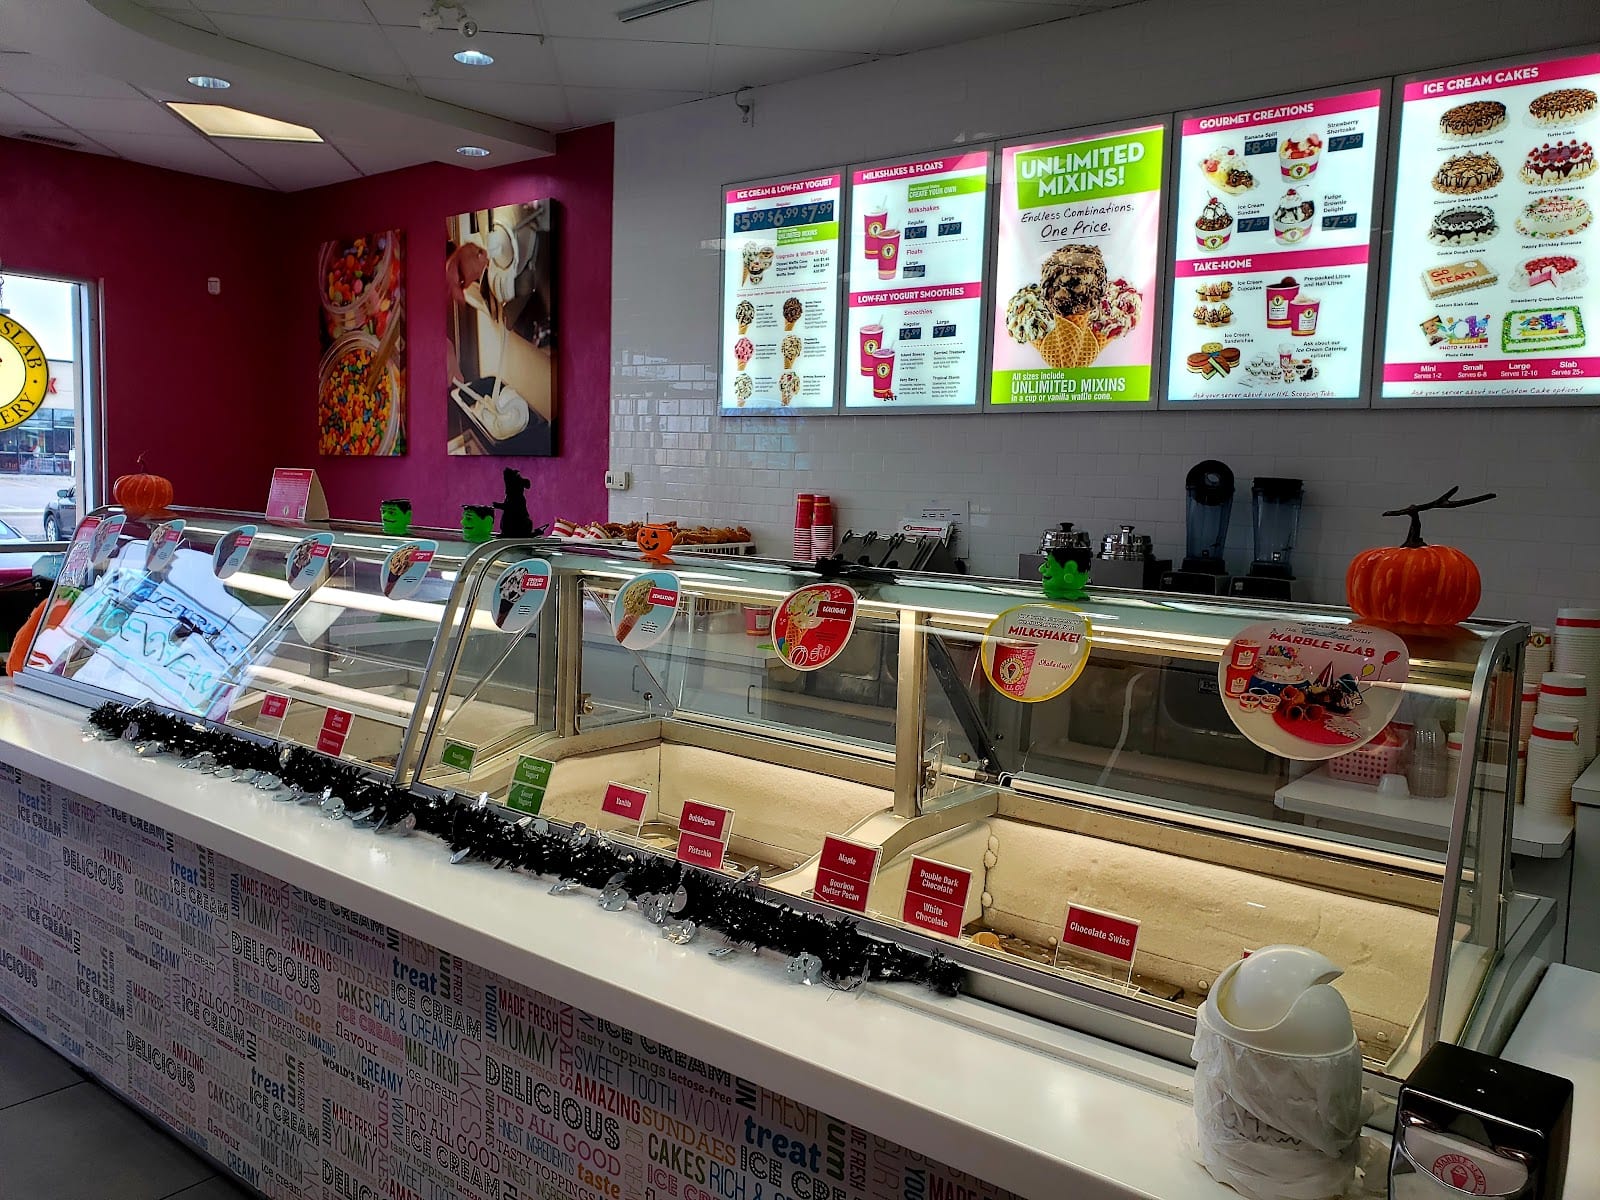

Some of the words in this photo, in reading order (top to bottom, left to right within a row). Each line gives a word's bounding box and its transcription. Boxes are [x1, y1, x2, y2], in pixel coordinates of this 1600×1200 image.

[1423, 82, 1444, 94] ICE
[1446, 74, 1492, 90] CREAM
[1495, 68, 1539, 83] CAKES
[1200, 112, 1251, 129] GOURMET
[1252, 103, 1314, 121] CREATIONS
[863, 166, 909, 180] MILKSHAKES
[916, 161, 944, 172] FLOATS
[1021, 142, 1145, 179] UNLIMITED
[737, 190, 748, 200] ICE
[748, 188, 771, 198] CREAM
[805, 178, 833, 190] YOGURT
[1038, 165, 1125, 198] MIXINS!
[735, 212, 764, 230] $5.99
[768, 207, 798, 226] $6.99
[802, 202, 832, 223] $7.99
[1020, 212, 1060, 223] Endless
[1064, 202, 1134, 218] Combinations.
[1041, 224, 1068, 238] One
[1072, 220, 1111, 235] Price.
[1193, 259, 1252, 272] TAKE-HOME
[858, 294, 888, 304] LOW-FAT
[889, 290, 919, 301] YOGURT
[920, 287, 964, 298] SMOOTHIES
[1012, 372, 1020, 380] All
[1023, 372, 1039, 380] sizes
[1040, 371, 1065, 380] include
[1509, 362, 1530, 371] Large
[1012, 380, 1076, 394] UNLIMITED
[1080, 377, 1126, 392] MIXINS
[1048, 392, 1070, 401] vanilla
[1008, 626, 1081, 643] MILKSHAKE!
[1268, 633, 1332, 651] MARBLE
[1333, 641, 1376, 658] SLAB
[838, 853, 857, 866] Maple
[822, 884, 841, 897] Butter
[830, 878, 855, 891] Bourbon
[920, 868, 943, 883] Double
[943, 874, 959, 888] Dark
[922, 879, 954, 895] Chocolate
[915, 911, 948, 928] Chocolate
[923, 902, 943, 916] White
[1070, 922, 1107, 940] Chocolate
[1107, 932, 1131, 947] Swiss
[232, 930, 320, 994] DELICIOUS
[290, 936, 332, 972] AMAZING
[392, 956, 438, 996] treat
[337, 977, 372, 1014] CAKES
[374, 994, 396, 1026] RICH
[411, 1013, 458, 1056] CREAMY
[391, 980, 416, 1010] ICE
[421, 994, 482, 1042] CREAM
[485, 984, 498, 1042] YOGURT
[499, 987, 525, 1020] MADE
[528, 1000, 558, 1035] FRESH
[246, 1030, 257, 1062] FUN
[498, 1009, 558, 1070] YUMMY
[576, 1028, 604, 1049] tasty
[608, 1042, 666, 1077] toppings
[252, 1066, 286, 1103] treat
[361, 1055, 404, 1096] CREAMY
[574, 1045, 623, 1088] SWEET
[629, 1070, 678, 1115] TOOTH
[669, 1069, 732, 1106] lactose-free
[486, 1055, 620, 1150] DELICIOUS
[575, 1072, 640, 1124] AMAZING
[680, 1088, 740, 1142] WOW
[332, 1120, 378, 1174] YUMMY
[404, 1103, 426, 1132] IT'S
[430, 1118, 453, 1148] ALL
[457, 1134, 500, 1174] GOOD
[496, 1095, 524, 1125] IT'S
[528, 1113, 559, 1145] ALL
[563, 1132, 620, 1176] GOOD
[642, 1106, 736, 1166] SUNDAES
[744, 1115, 821, 1173] treat
[406, 1126, 432, 1160] ICE
[437, 1146, 500, 1200] CREAM
[496, 1138, 532, 1170] TASTY
[649, 1132, 705, 1184] CAKES
[740, 1145, 782, 1189] ICE
[577, 1161, 620, 1199] taste
